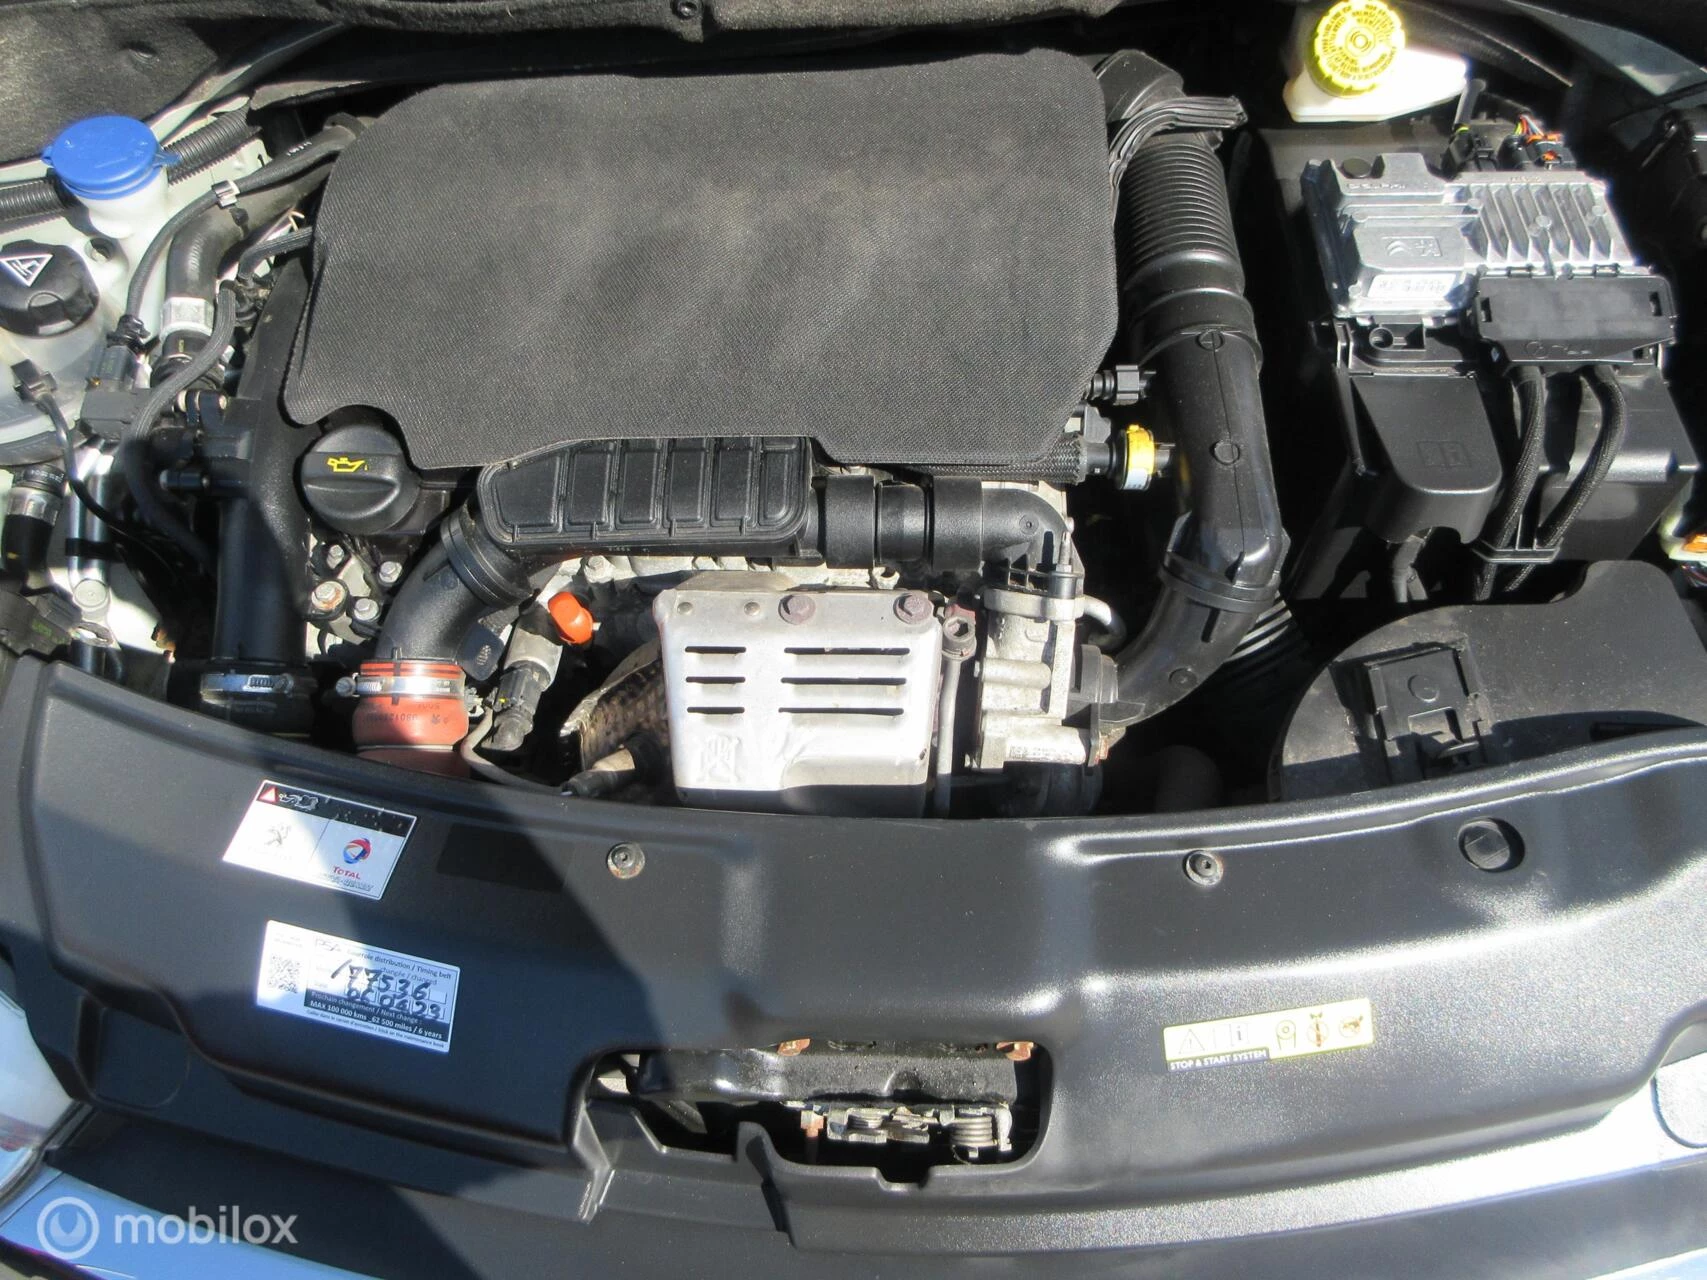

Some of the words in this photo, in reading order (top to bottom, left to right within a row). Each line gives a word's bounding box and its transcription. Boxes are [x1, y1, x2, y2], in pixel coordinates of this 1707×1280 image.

[333, 865, 361, 880] TOTAL
[374, 955, 411, 970] distribution
[416, 964, 438, 977] Timing
[438, 971, 452, 980] belt
[310, 1000, 326, 1010] MAX
[328, 1004, 340, 1014] 100
[340, 1008, 353, 1017] 000
[353, 1010, 367, 1021] kms
[381, 1019, 394, 1027] 500
[394, 1022, 412, 1032] miles
[424, 1030, 442, 1040] years
[339, 998, 375, 1013] changement
[380, 1009, 396, 1018] Next
[396, 1013, 419, 1024] change
[1170, 1060, 1194, 1070] STOP
[1203, 1055, 1232, 1066] START
[1232, 1048, 1267, 1062] SYSTEM
